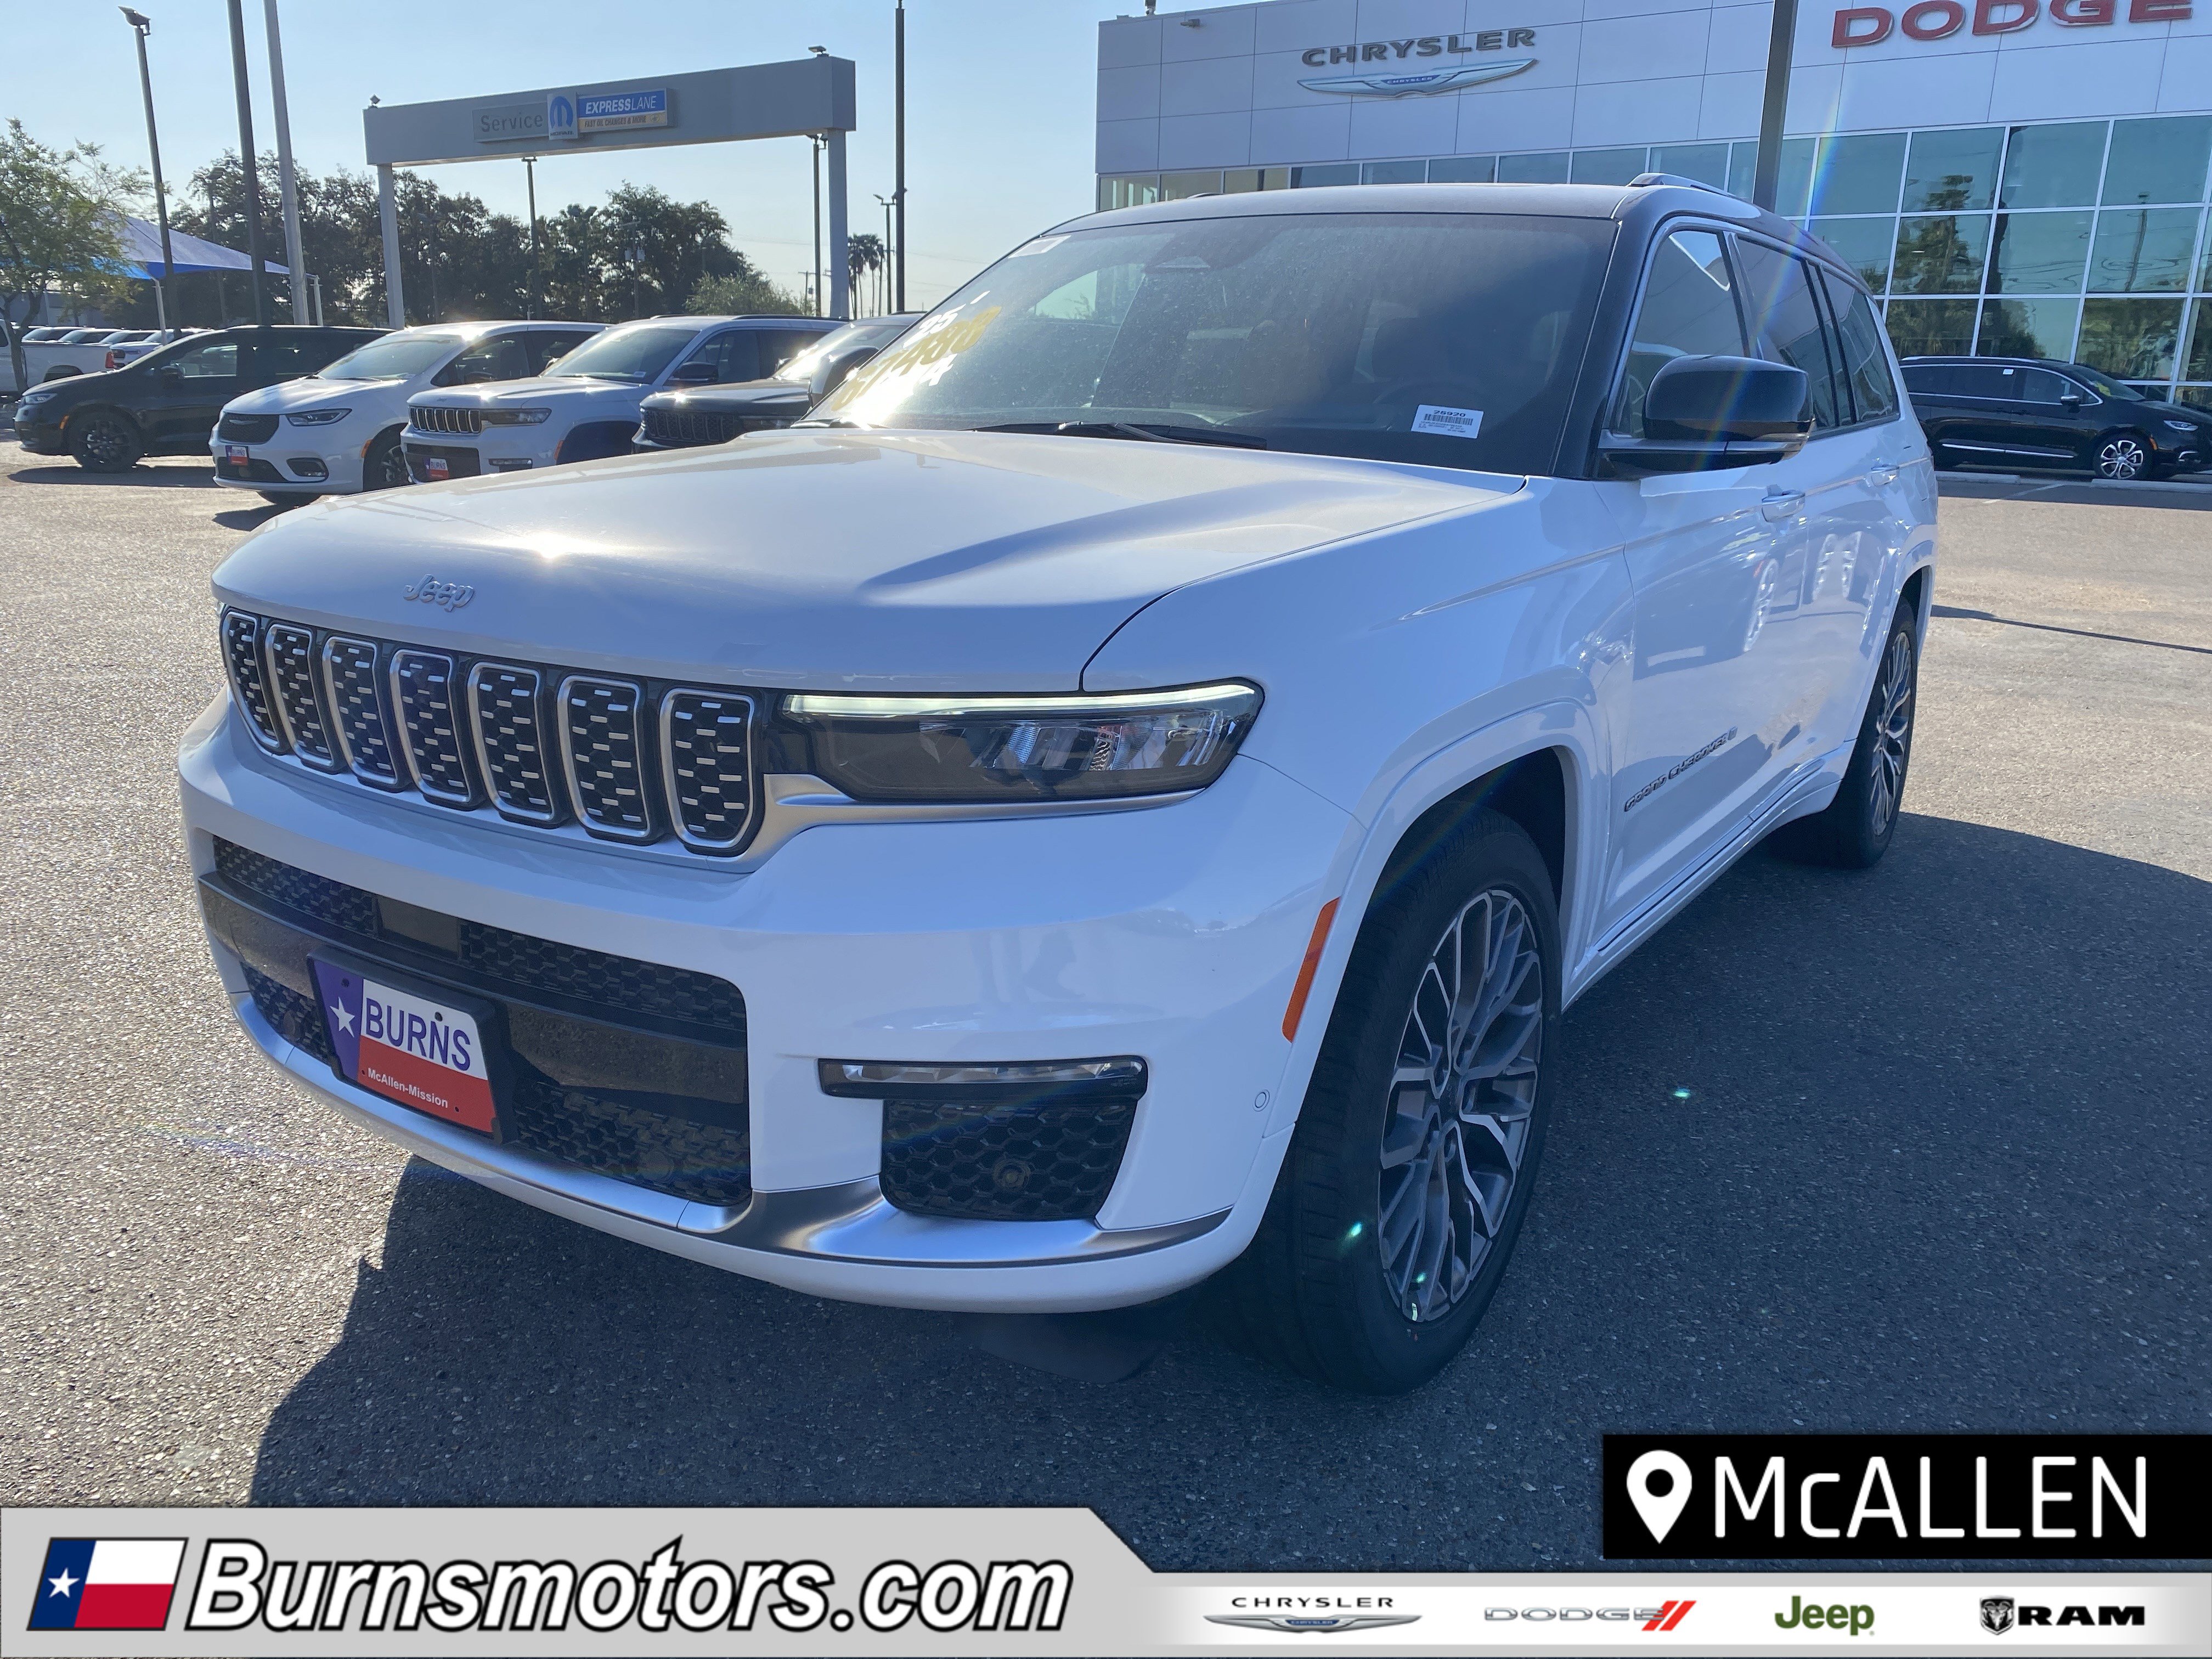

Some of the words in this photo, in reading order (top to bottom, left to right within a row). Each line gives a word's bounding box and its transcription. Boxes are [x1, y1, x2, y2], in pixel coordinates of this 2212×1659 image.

[1831, 0, 2193, 48] DODGE
[1302, 29, 1536, 66] CHRYSLER
[481, 112, 543, 133] Service
[585, 119, 595, 128] FAST
[605, 117, 626, 126] CHANGES
[632, 115, 646, 123] MORE
[430, 460, 446, 470] BURNS
[403, 574, 475, 612] Jeep
[366, 997, 471, 1071] BURNS
[368, 1068, 449, 1109] McAllen-Mission
